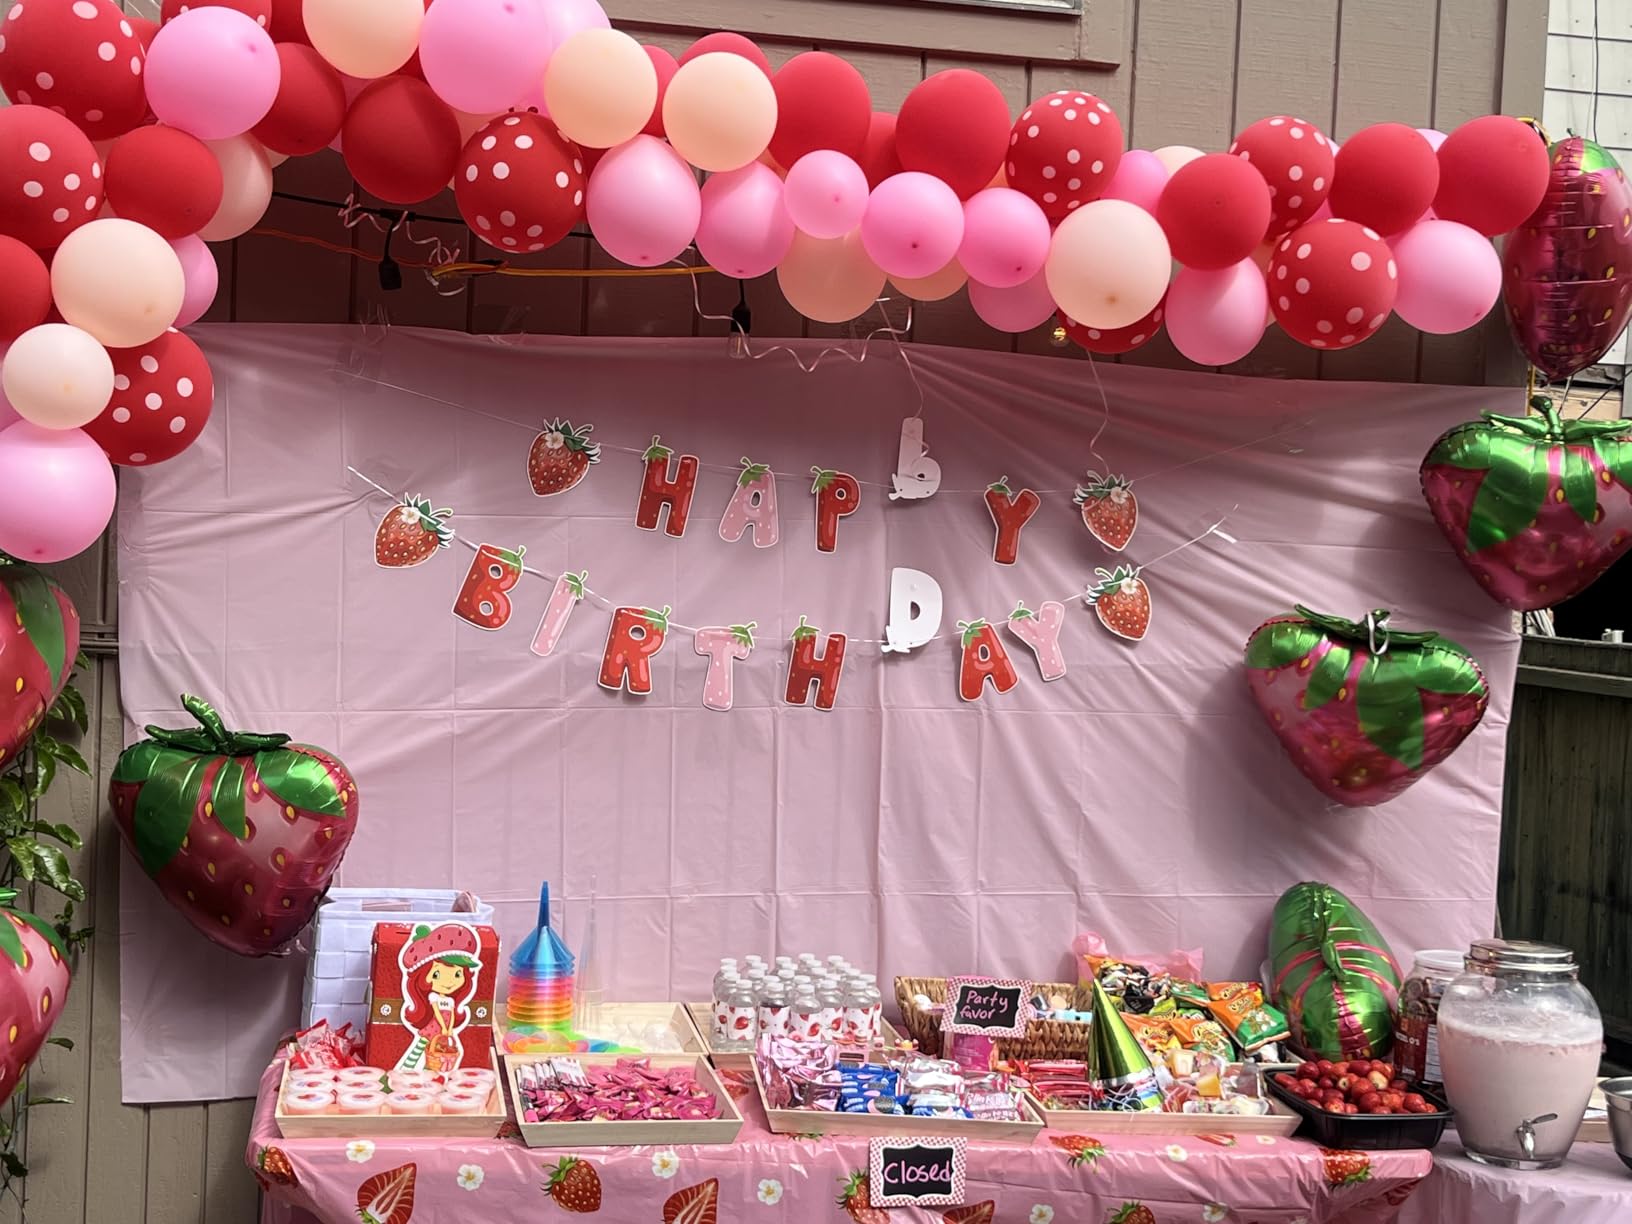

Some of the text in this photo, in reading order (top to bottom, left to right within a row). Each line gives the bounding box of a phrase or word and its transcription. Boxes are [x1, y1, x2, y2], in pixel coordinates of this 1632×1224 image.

[452, 543, 1065, 712] BIRTHDAY
[960, 1004, 995, 1019] favor
[966, 990, 1008, 1013] Party
[883, 1160, 951, 1185] Closed
